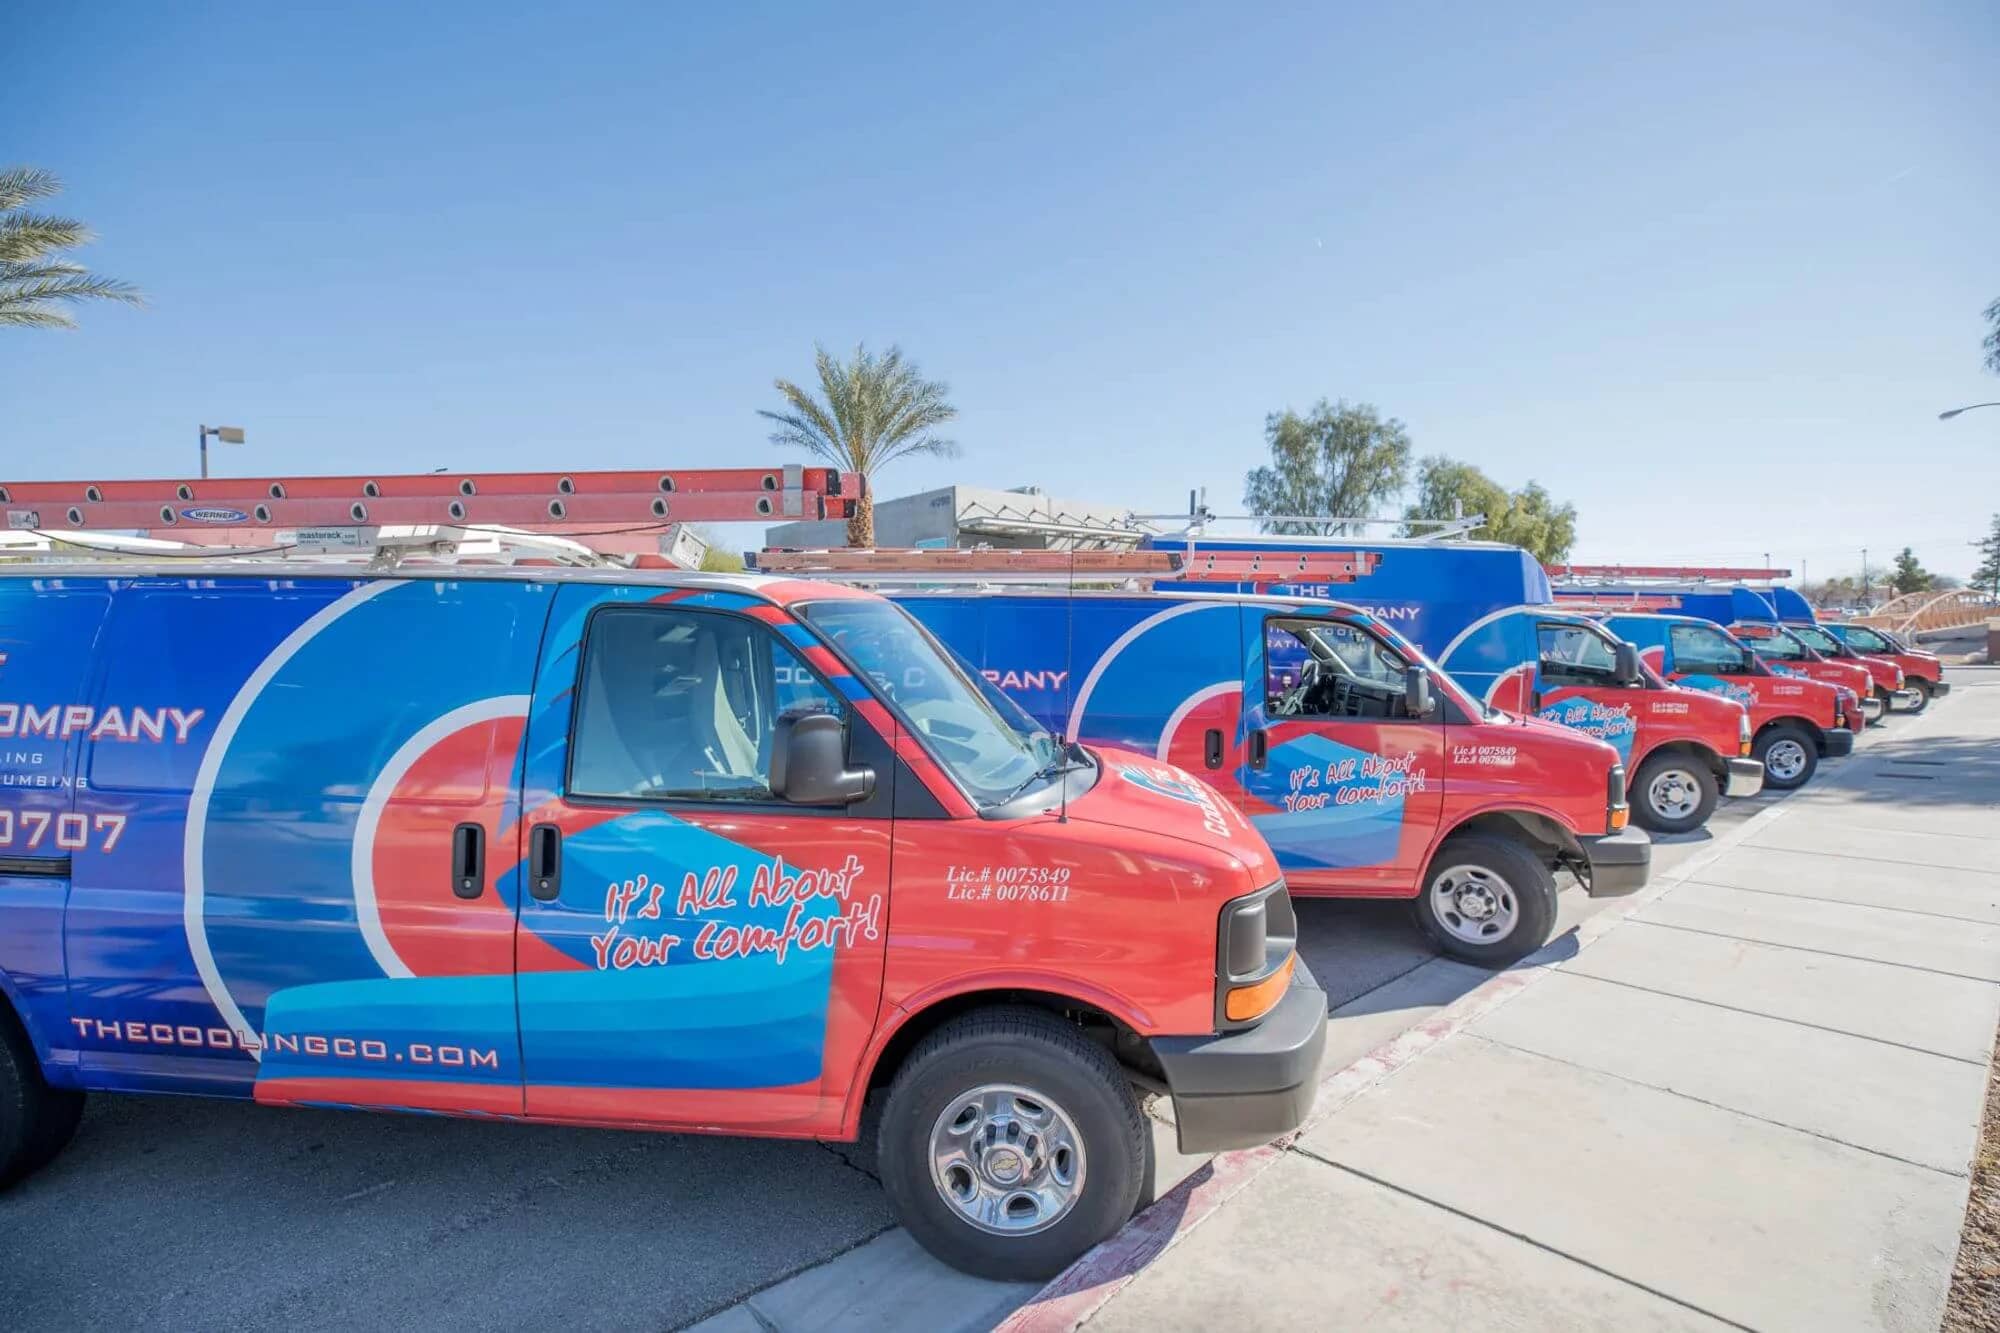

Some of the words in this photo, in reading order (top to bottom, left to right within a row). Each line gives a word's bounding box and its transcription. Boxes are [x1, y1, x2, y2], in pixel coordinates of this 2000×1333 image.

[194, 511, 235, 519] WERNER
[1286, 585, 1330, 597] THE
[1565, 706, 1589, 723] All
[1592, 702, 1632, 721] About
[1574, 715, 1637, 739] omfort!
[0, 752, 43, 764] ING
[0, 774, 88, 788] UMBING
[1290, 765, 1320, 790] It's
[1326, 759, 1356, 784] All
[1361, 751, 1416, 779] About
[1285, 791, 1329, 813] Your
[1336, 769, 1425, 805] Comfort!
[946, 865, 991, 882] Lic.#
[996, 866, 1070, 884] 0075849
[605, 874, 664, 923] It's
[676, 864, 738, 915] All
[750, 854, 864, 910] About
[947, 883, 992, 900] Lic.#
[996, 885, 1069, 901] 0078611
[591, 926, 681, 970] Your
[693, 894, 881, 965] Comfort!
[71, 1016, 499, 1069] THECOOLINGCO.COM
